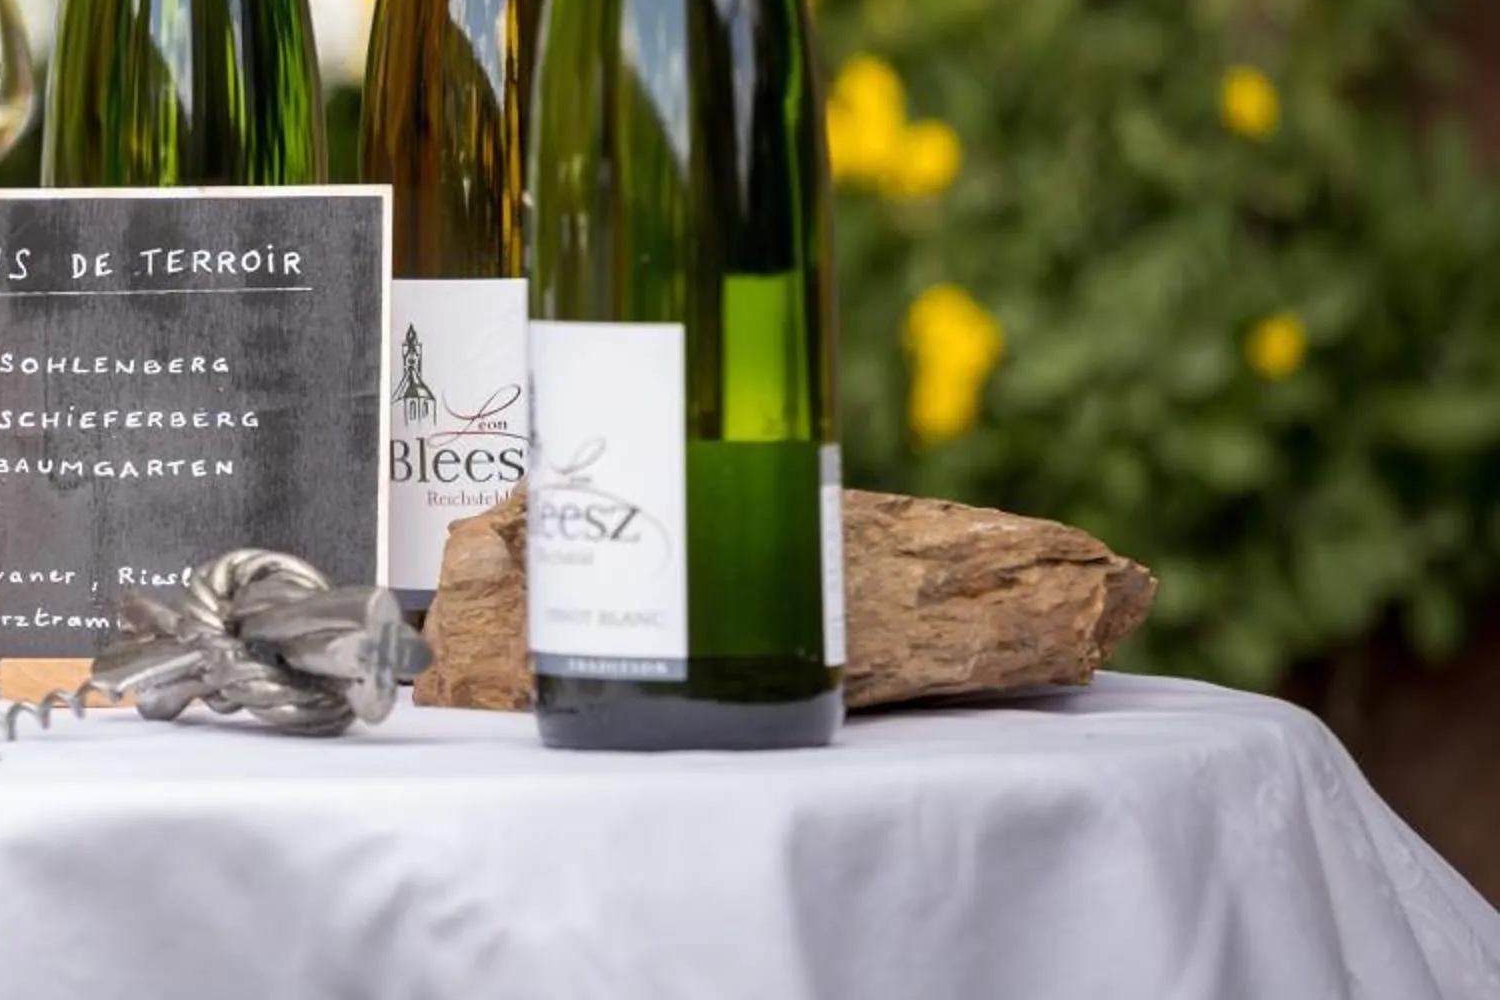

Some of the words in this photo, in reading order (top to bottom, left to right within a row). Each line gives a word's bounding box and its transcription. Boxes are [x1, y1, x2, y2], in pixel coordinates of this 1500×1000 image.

[71, 252, 113, 279] DE
[389, 436, 526, 484] Blees
[117, 565, 192, 588] Riesl
